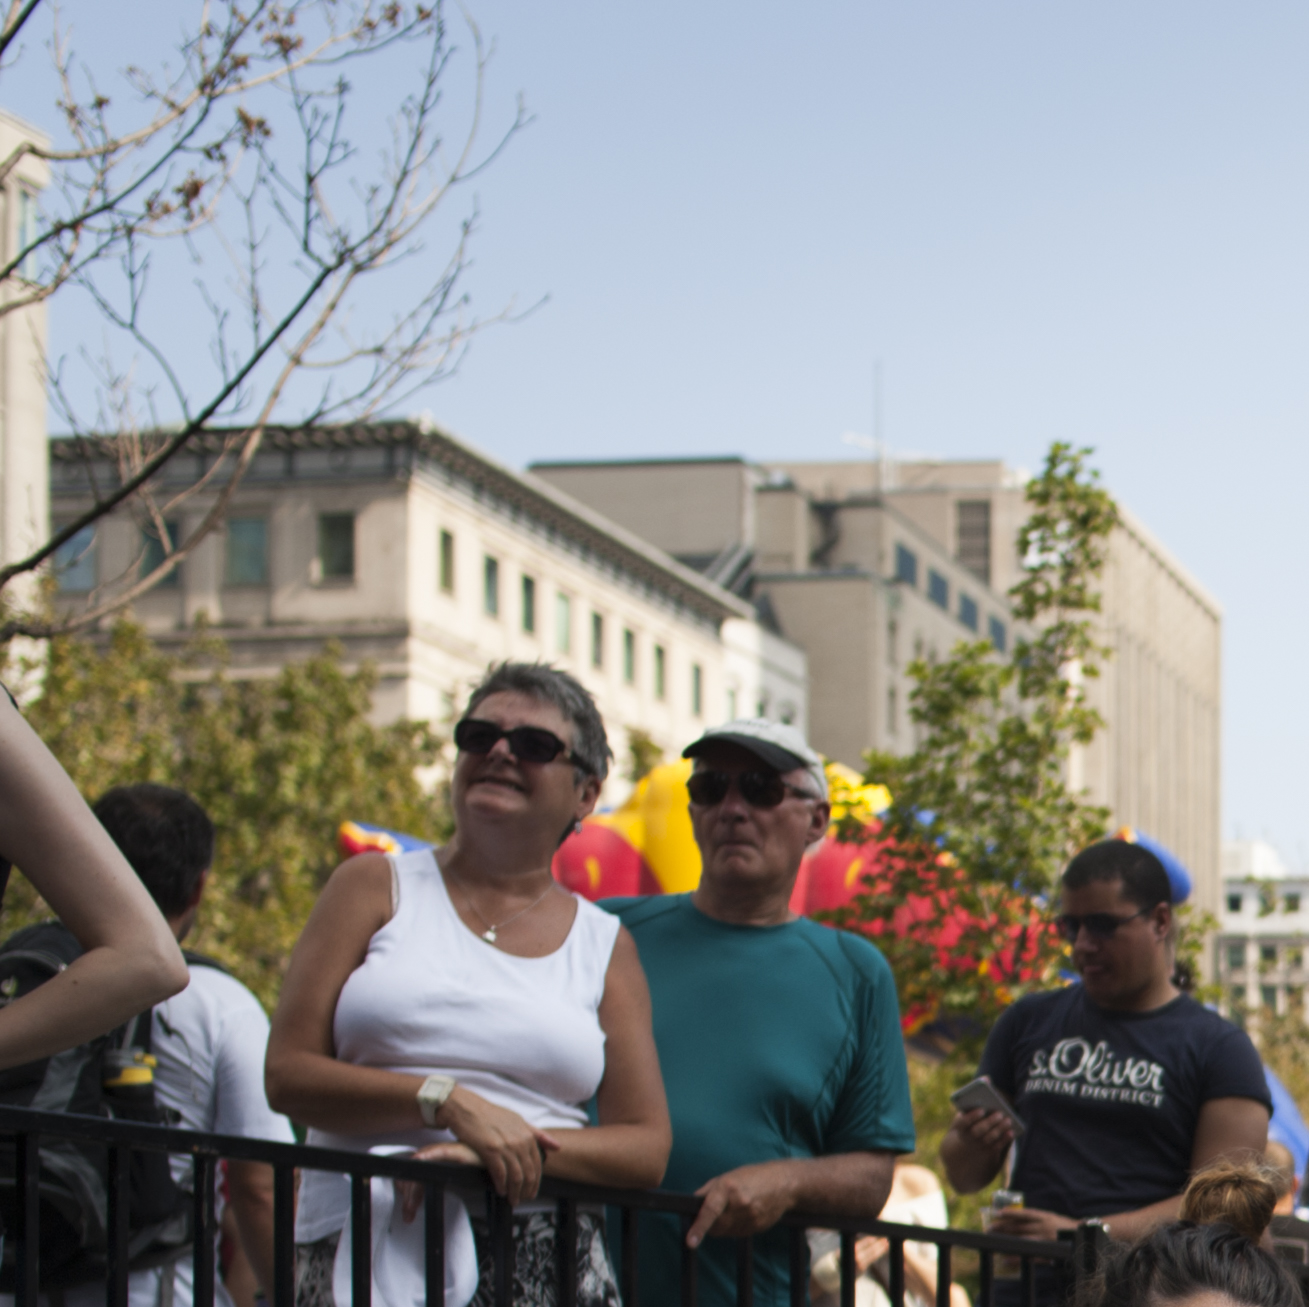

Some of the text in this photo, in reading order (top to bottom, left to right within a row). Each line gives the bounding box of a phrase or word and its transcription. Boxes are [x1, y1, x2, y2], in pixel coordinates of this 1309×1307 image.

[1029, 1036, 1164, 1091] s.Oliver
[1025, 1078, 1164, 1108] DENIM DISTRICT
